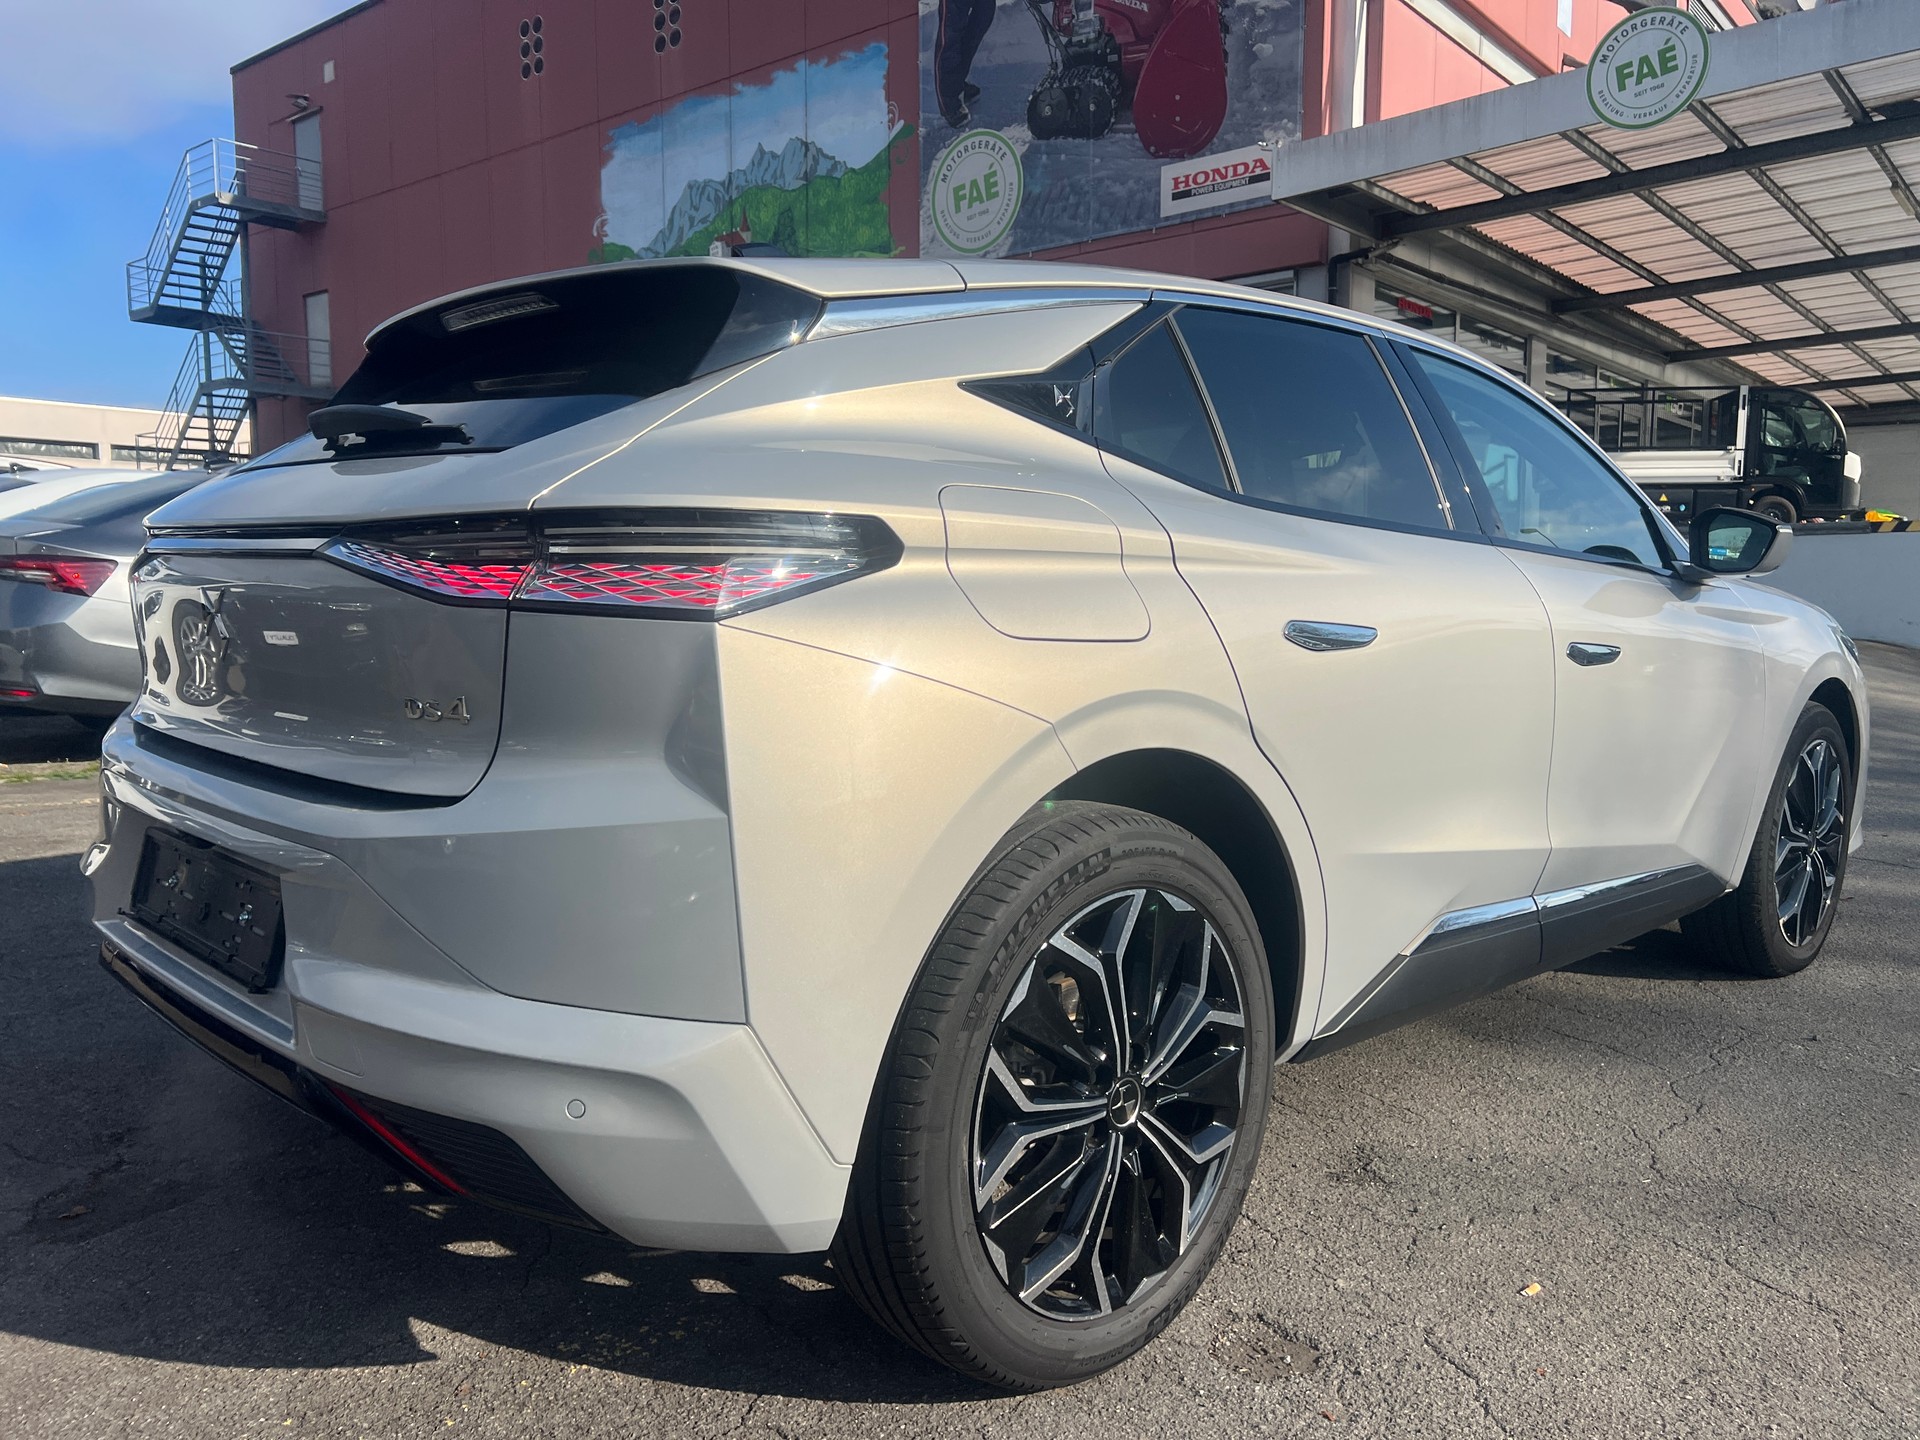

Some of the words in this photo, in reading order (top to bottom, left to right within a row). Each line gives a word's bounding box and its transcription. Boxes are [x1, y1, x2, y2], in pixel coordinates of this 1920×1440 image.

[1600, 16, 1689, 64] MOTORGERÄTE
[1597, 89, 1624, 118] BERATUNG
[1633, 104, 1668, 119] VERKAUF
[1675, 54, 1698, 99] REPARATUR
[1615, 37, 1679, 93] FAÉ
[1633, 88, 1648, 98] SEIT
[941, 140, 1008, 184] MOTORGERÄTE
[1172, 158, 1271, 191] HONDA
[952, 162, 1000, 214] FAÉ
[1191, 184, 1214, 196] POWER
[1214, 177, 1250, 192] EQUIPMENT
[987, 849, 1109, 984] MICHELIN
